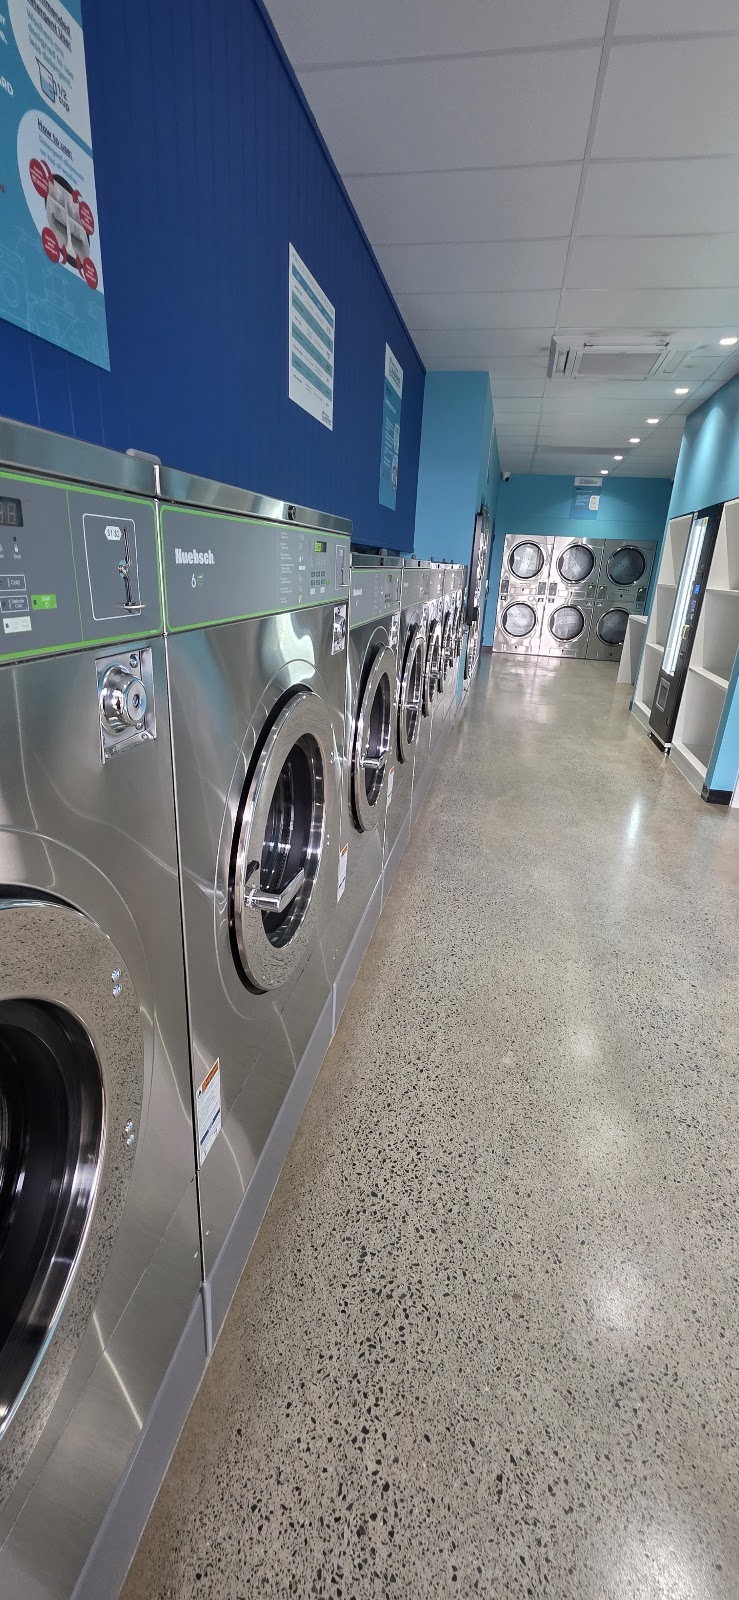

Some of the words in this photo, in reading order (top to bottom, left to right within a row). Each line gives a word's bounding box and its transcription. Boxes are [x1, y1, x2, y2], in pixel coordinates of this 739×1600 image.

[57, 83, 67, 101] 1/2
[59, 96, 70, 112] cup
[37, 117, 52, 139] How
[53, 133, 60, 147] to
[174, 548, 214, 565] Huebsch
[191, 573, 197, 588] 6
